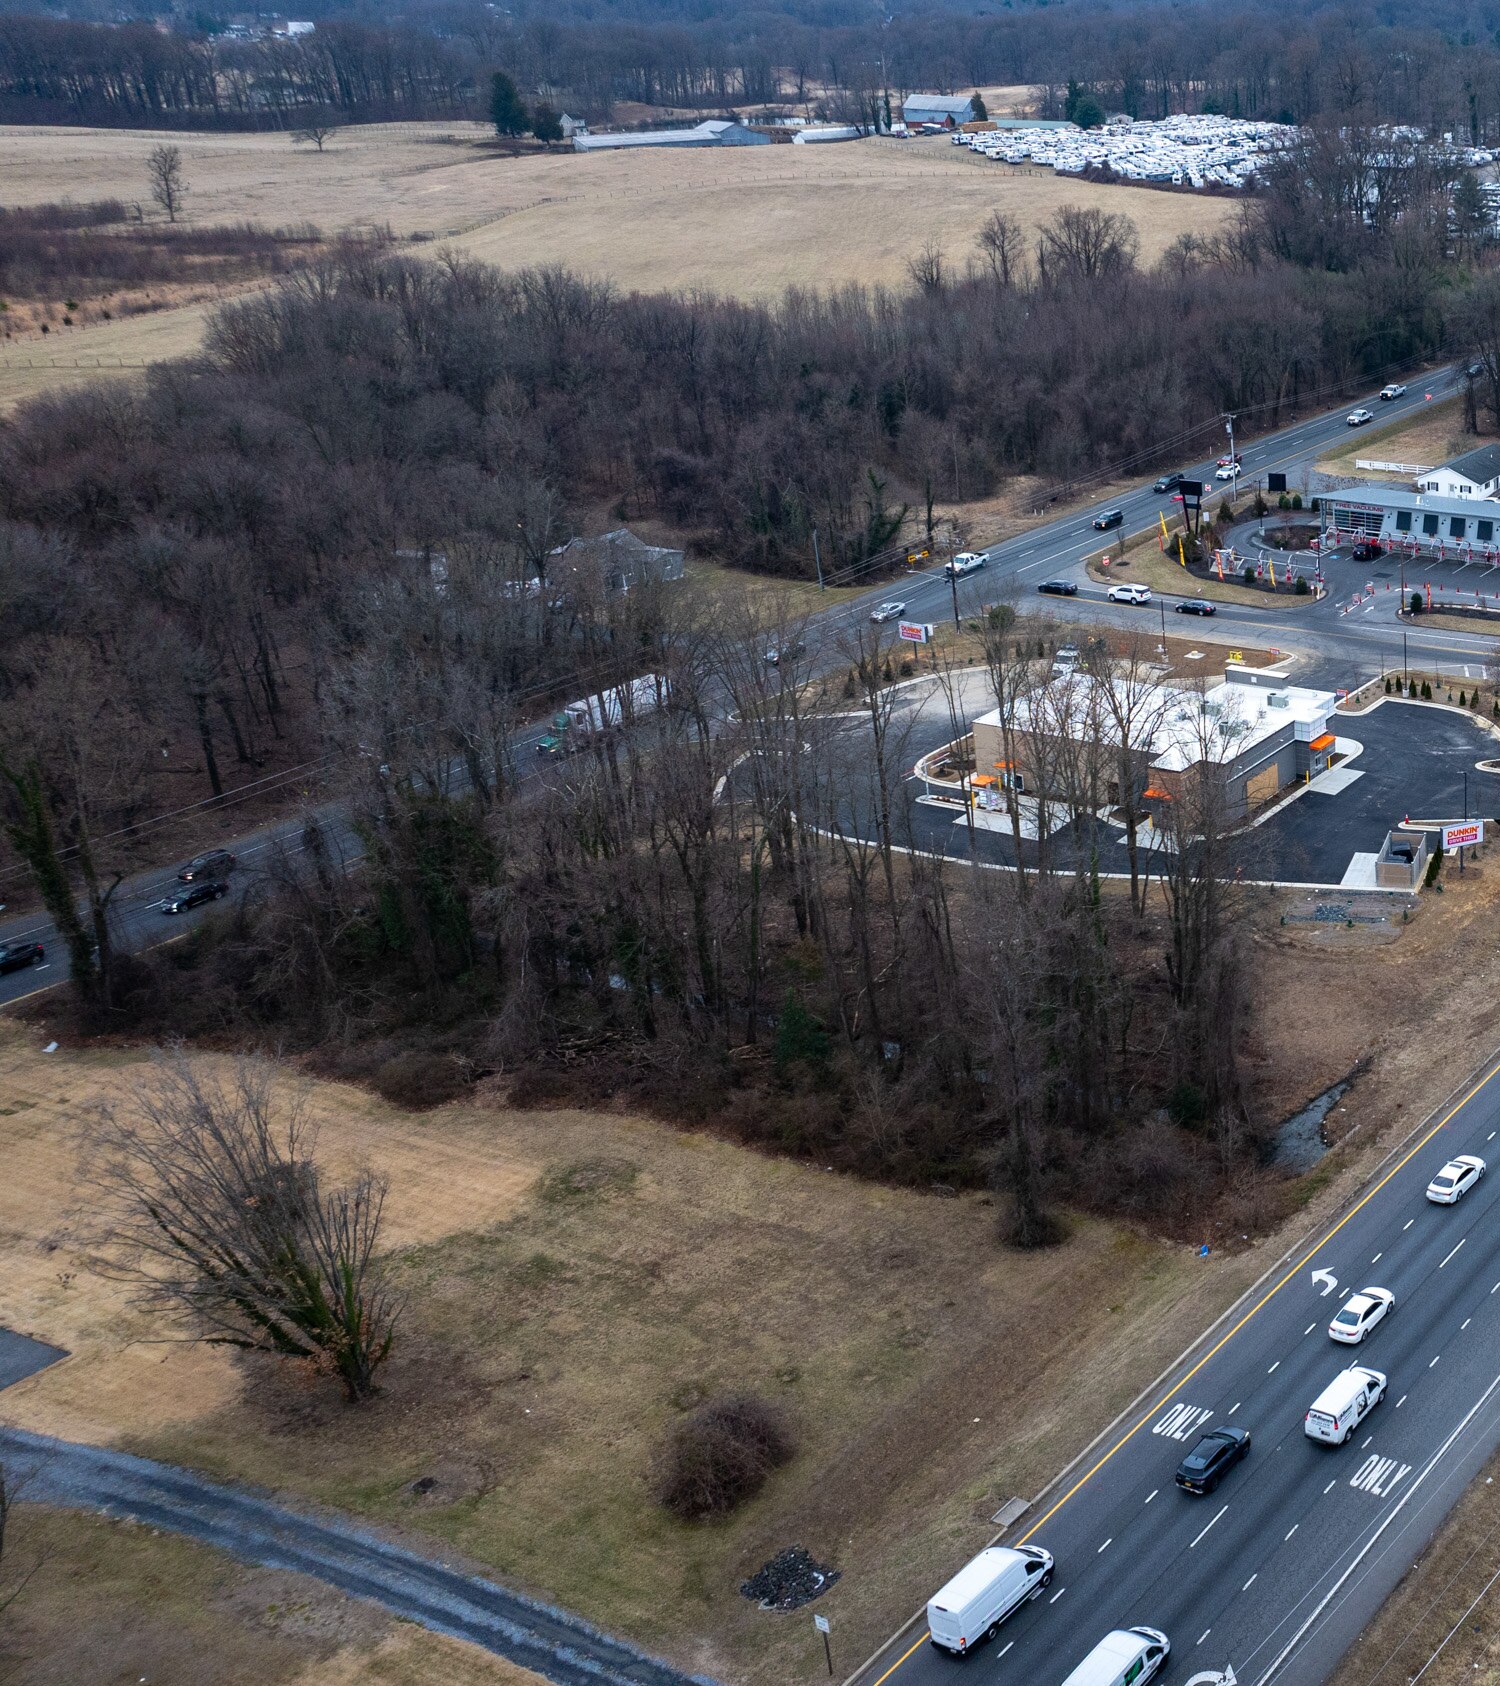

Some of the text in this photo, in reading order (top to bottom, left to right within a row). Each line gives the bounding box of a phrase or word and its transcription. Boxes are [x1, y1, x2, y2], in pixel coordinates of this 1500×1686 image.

[1447, 825, 1479, 839] DUNKIN'
[1152, 1402, 1214, 1442] ONLY
[1350, 1454, 1412, 1497] ONLY
